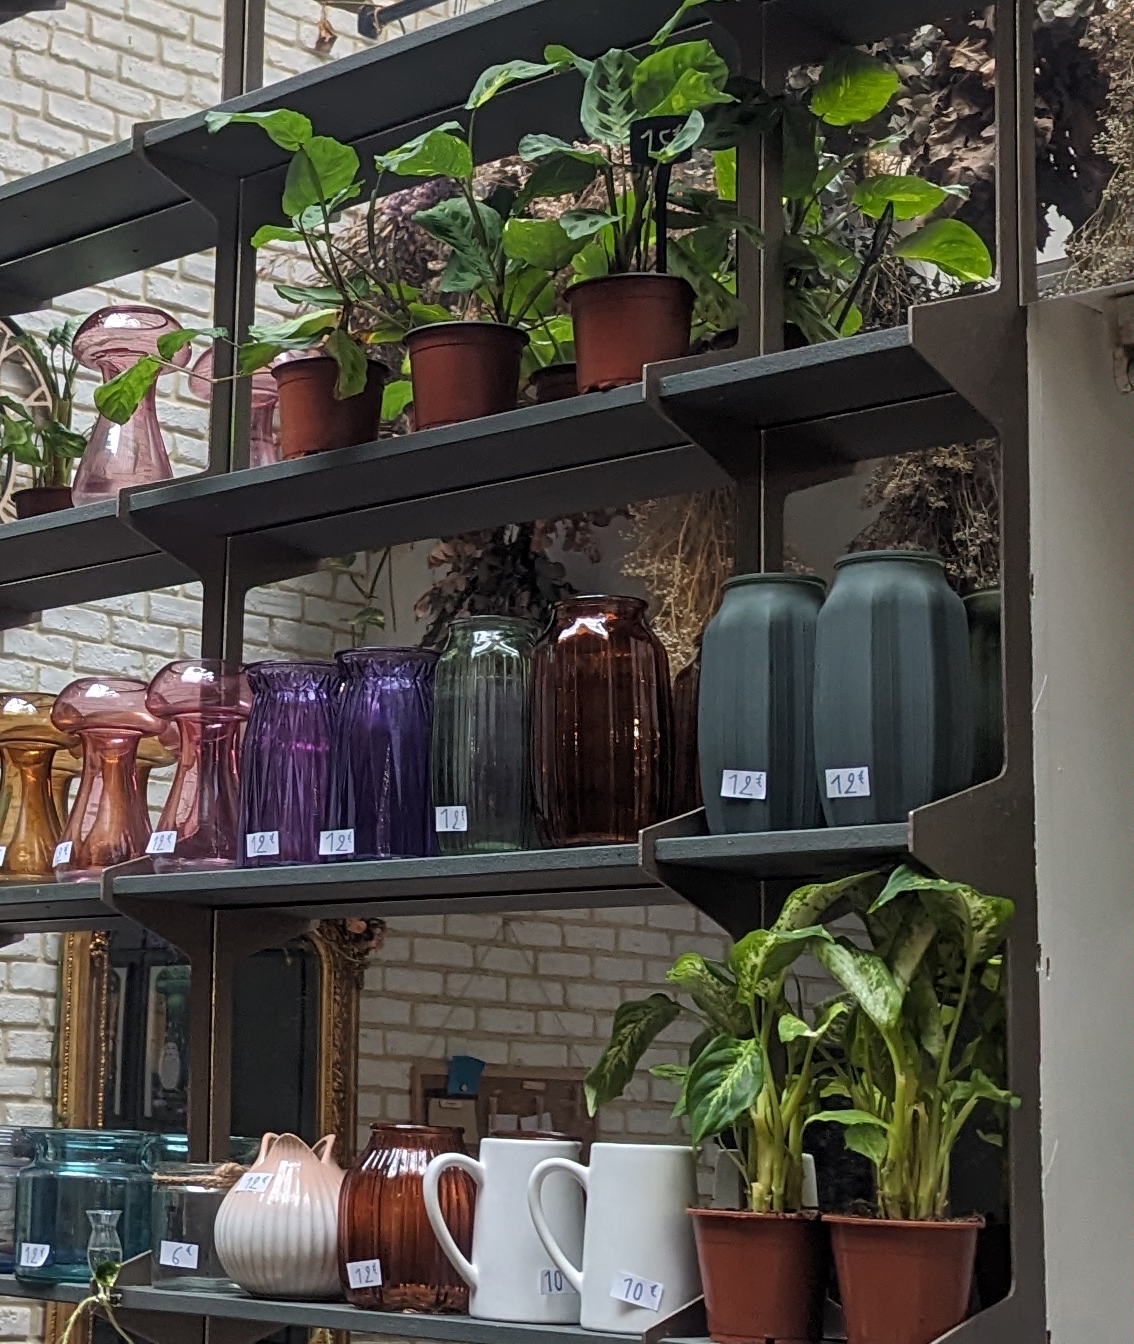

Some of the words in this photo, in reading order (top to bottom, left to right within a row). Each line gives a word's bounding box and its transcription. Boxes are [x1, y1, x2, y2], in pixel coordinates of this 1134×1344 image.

[729, 773, 763, 796] 12€
[831, 769, 864, 795] 12€
[440, 808, 466, 830] 12€
[153, 833, 173, 851] 12€
[251, 832, 276, 853] 12€
[326, 831, 353, 853] 12€
[244, 1175, 269, 1190] 12€
[25, 1246, 46, 1264] 12€
[171, 1245, 193, 1265] 6€
[355, 1263, 379, 1284] 12€
[623, 1277, 659, 1301] 10€
